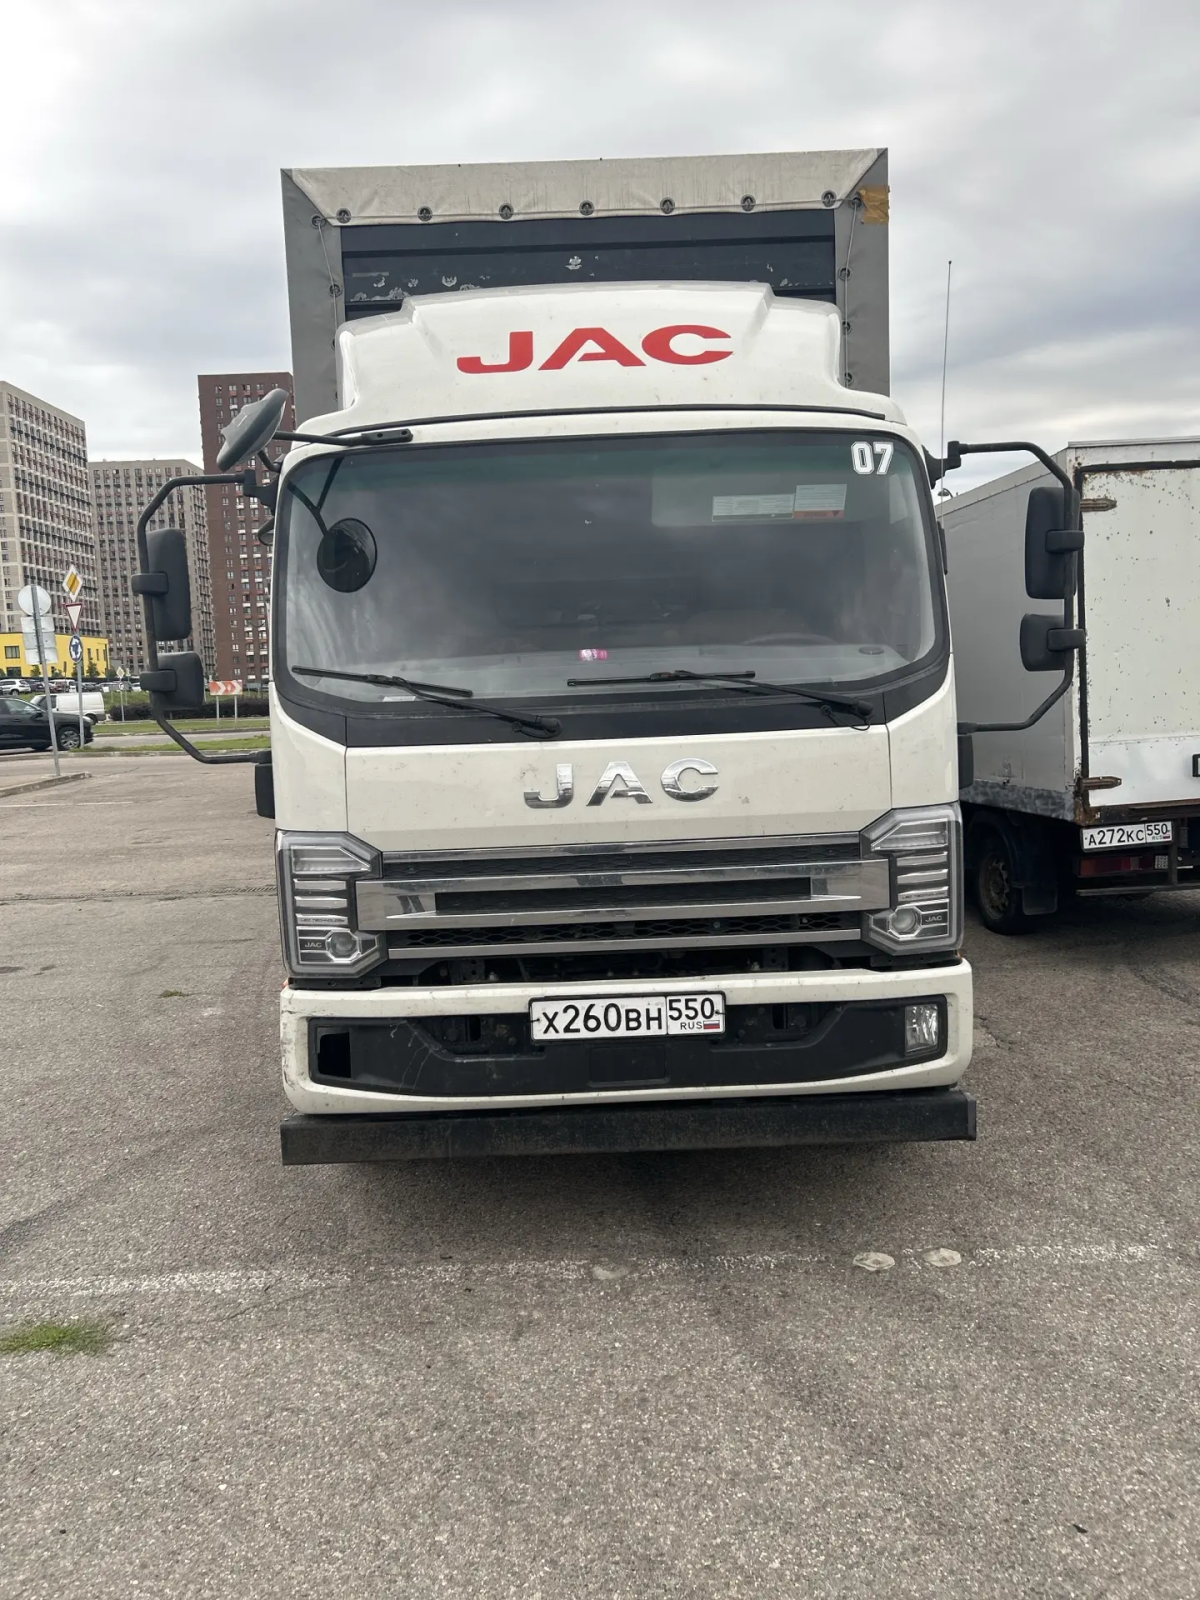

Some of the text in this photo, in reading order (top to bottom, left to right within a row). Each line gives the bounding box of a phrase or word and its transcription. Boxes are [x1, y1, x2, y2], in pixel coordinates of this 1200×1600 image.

[456, 324, 734, 374] JAC
[850, 441, 894, 475] 07
[523, 757, 719, 809] JAC
[1088, 823, 1168, 846] А272КС 550
[924, 915, 943, 923] JAC
[542, 997, 715, 1034] Х260ВН 550
[680, 1021, 703, 1030] RUS
